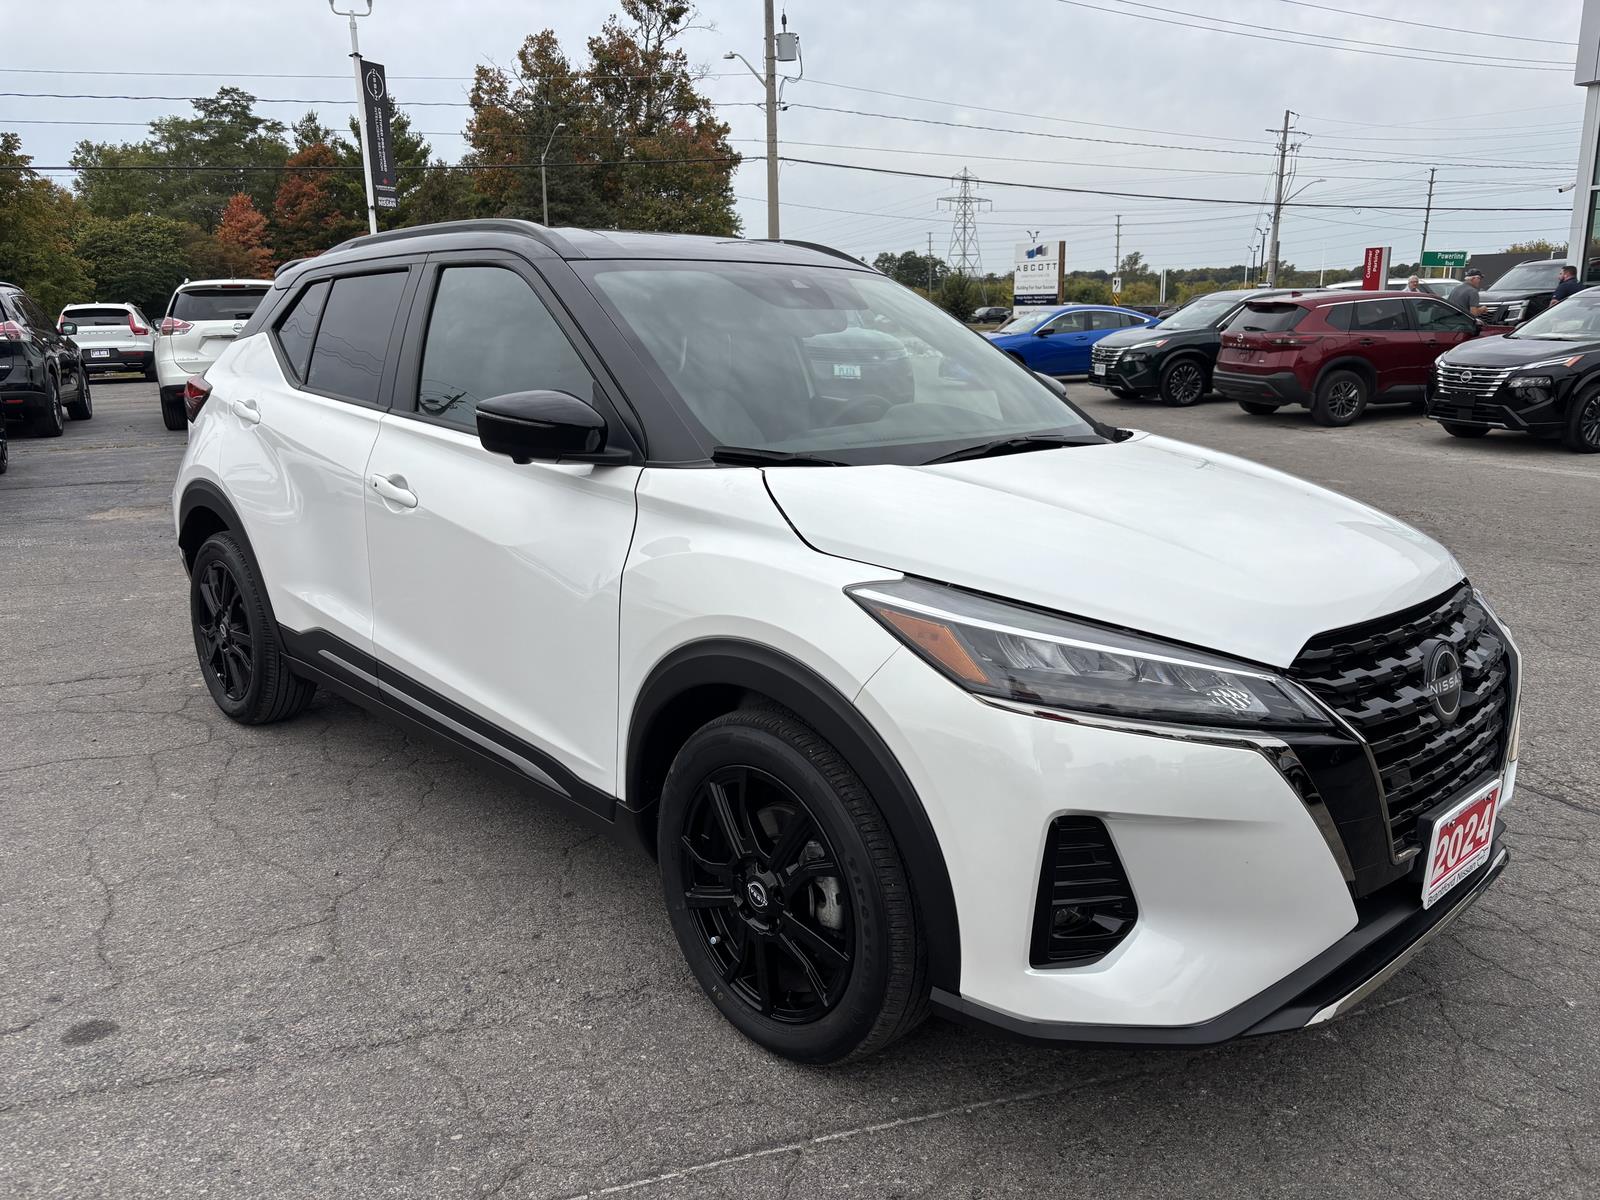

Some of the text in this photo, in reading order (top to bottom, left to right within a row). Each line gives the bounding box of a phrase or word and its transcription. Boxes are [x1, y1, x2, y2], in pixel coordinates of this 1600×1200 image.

[371, 68, 379, 102] NISSAN
[378, 200, 397, 208] NISSAN
[1437, 252, 1463, 260] Powerline
[1016, 263, 1057, 272] ABCOTT
[1432, 802, 1493, 880] 2024
[1427, 860, 1476, 907] Brantford Nissan
